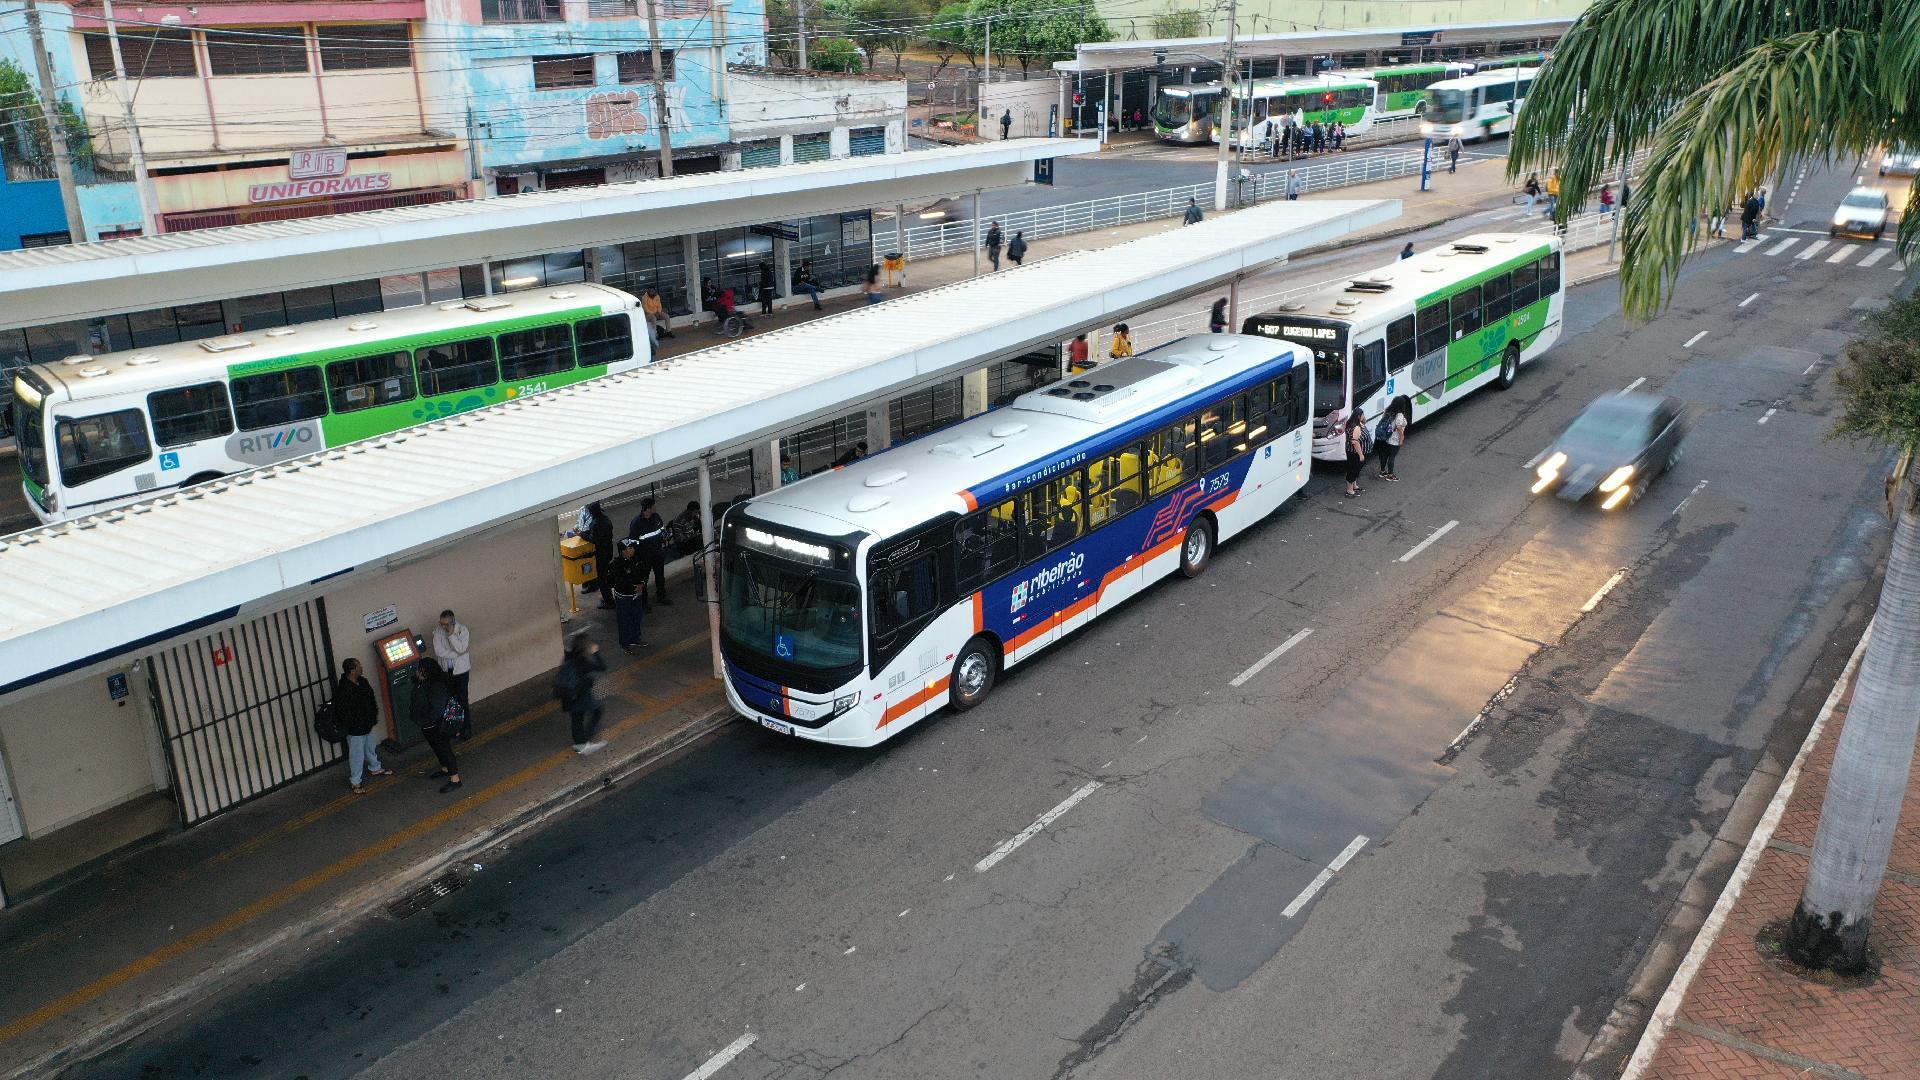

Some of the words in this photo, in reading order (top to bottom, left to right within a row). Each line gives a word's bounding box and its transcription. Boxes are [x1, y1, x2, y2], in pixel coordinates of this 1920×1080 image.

[301, 153, 335, 173] RIB
[1038, 159, 1049, 176] H
[251, 174, 390, 200] UNIFORMES
[1313, 328, 1336, 340] LOPES
[518, 381, 547, 396] 2541
[1011, 452, 1086, 490] ar-condicionado
[1209, 472, 1230, 493] 7579
[1030, 551, 1085, 594] ribeirão
